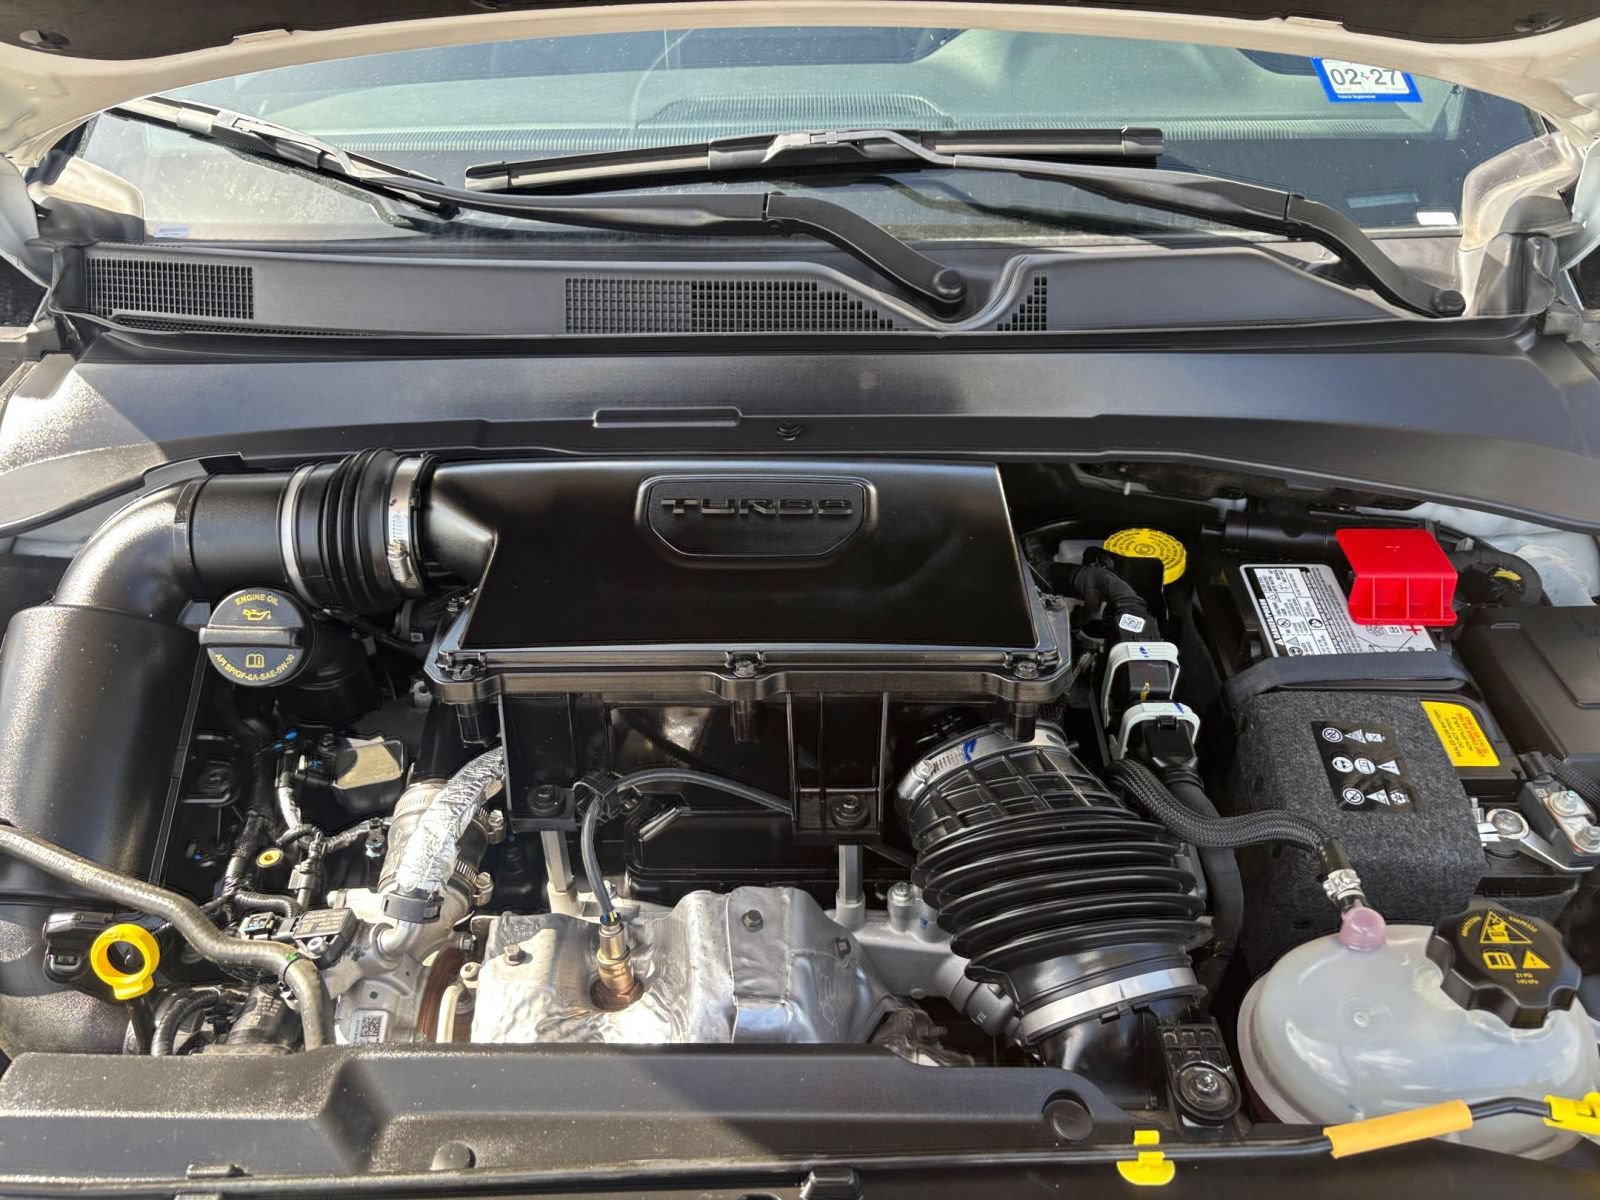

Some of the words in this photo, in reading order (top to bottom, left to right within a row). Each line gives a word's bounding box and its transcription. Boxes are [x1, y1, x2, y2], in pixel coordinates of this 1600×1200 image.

[1330, 68, 1362, 86] 02
[1369, 68, 1397, 86] 27
[660, 498, 853, 516] TURBO
[234, 593, 267, 606] ENGINE
[266, 595, 279, 606] OIL
[215, 653, 225, 667] API
